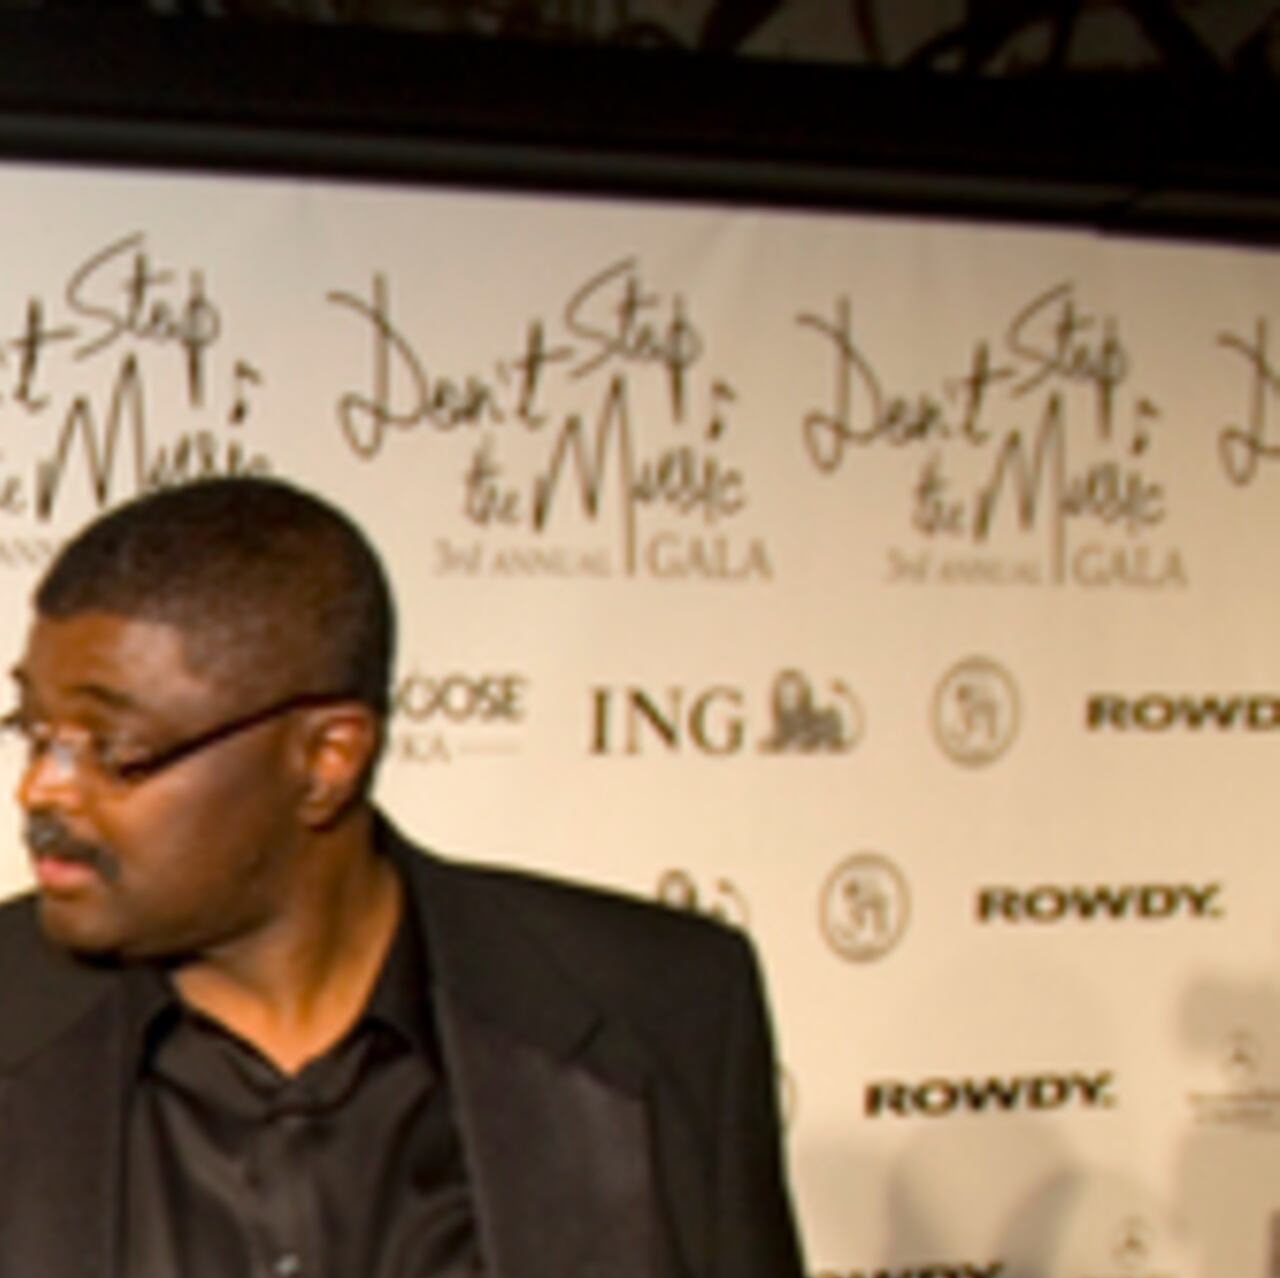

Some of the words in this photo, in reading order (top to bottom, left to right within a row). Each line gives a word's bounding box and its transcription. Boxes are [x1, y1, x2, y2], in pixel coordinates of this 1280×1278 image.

[64, 231, 222, 409] Stop
[326, 272, 574, 460] Don't
[564, 254, 703, 423] Stop
[794, 294, 1012, 474] Don't
[1007, 281, 1129, 440] Stop
[462, 432, 522, 530] the
[531, 373, 748, 578] Music
[647, 534, 775, 581] GALA
[973, 392, 1169, 585] Music
[1072, 546, 1189, 588] GALA
[393, 669, 529, 723] OOSE
[587, 685, 747, 757] ING
